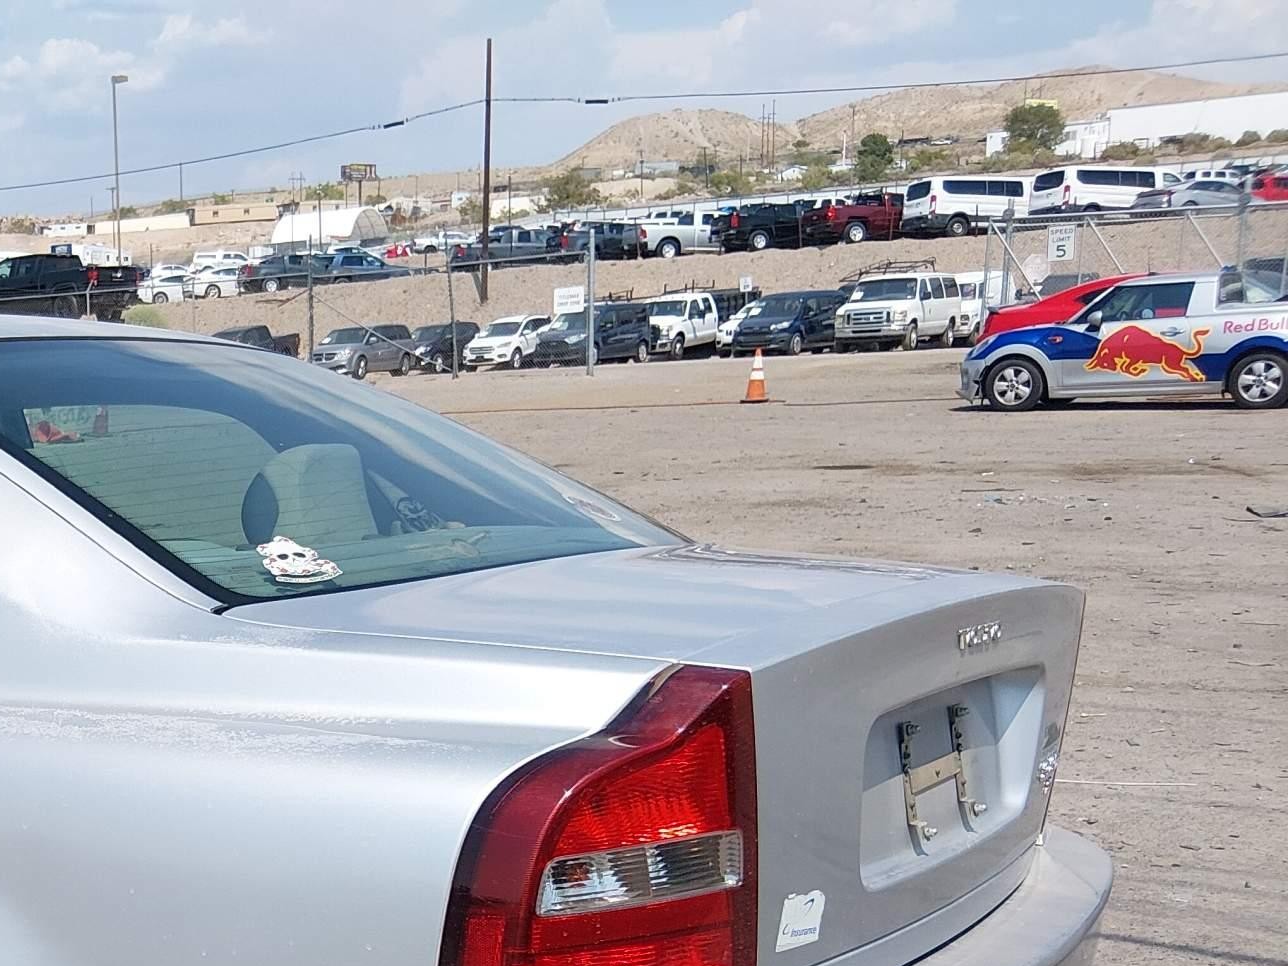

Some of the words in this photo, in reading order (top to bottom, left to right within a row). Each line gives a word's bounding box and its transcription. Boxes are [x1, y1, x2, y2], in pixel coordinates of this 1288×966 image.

[1050, 228, 1074, 236] SPEED
[1055, 244, 1067, 258] 5
[1224, 319, 1256, 334] Red
